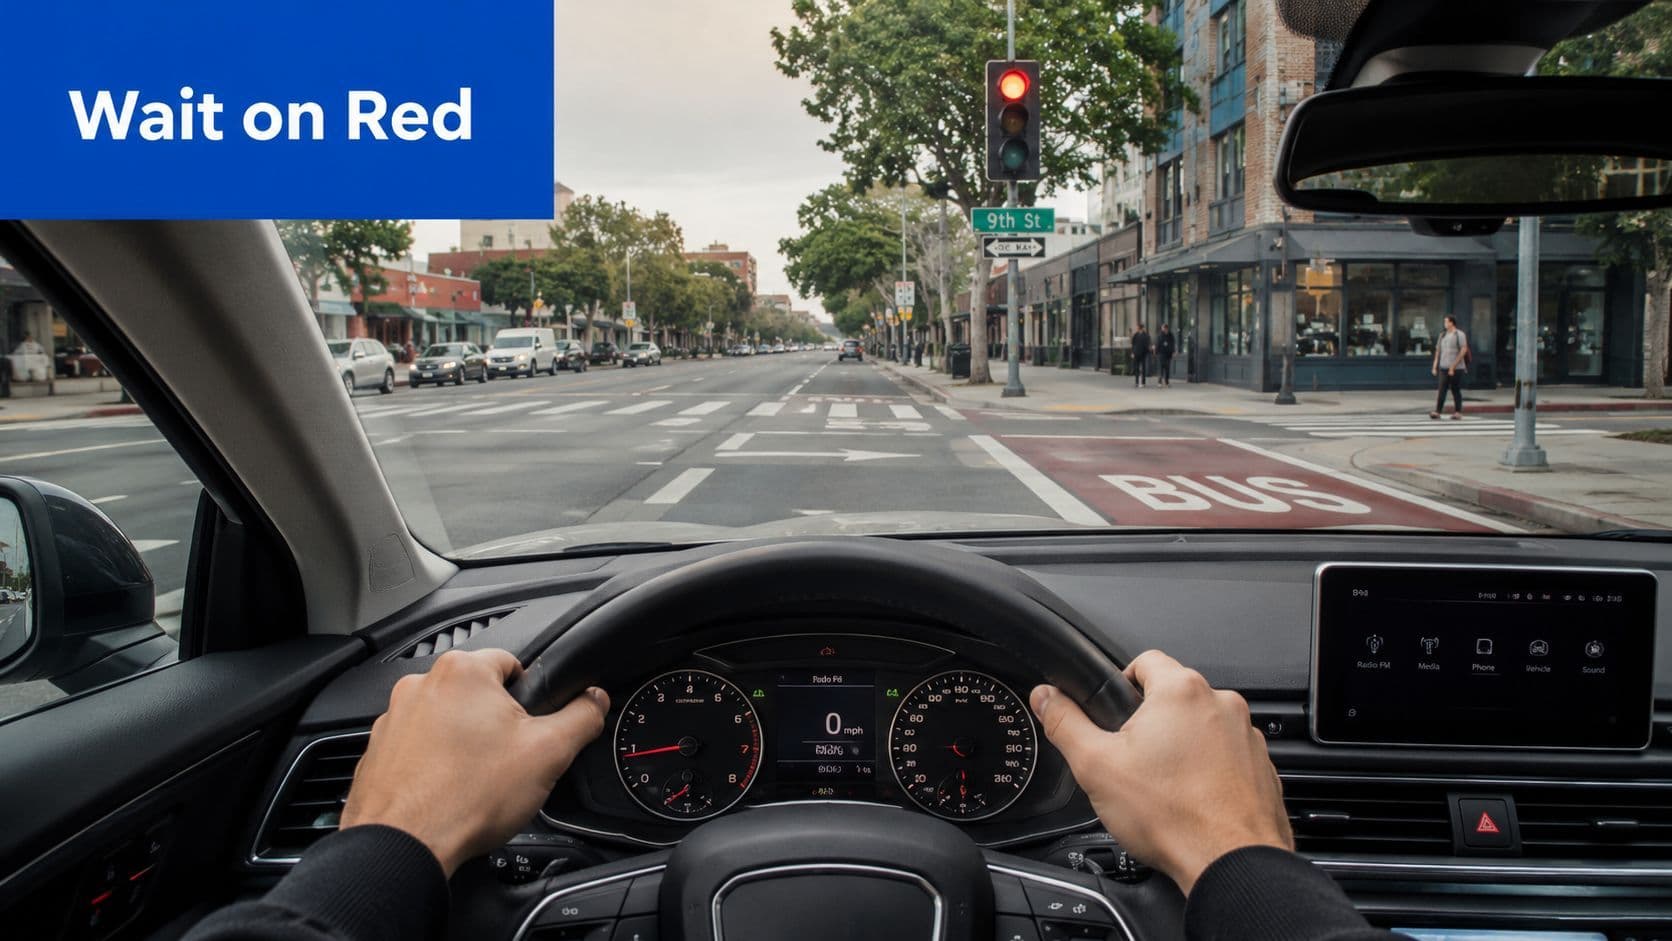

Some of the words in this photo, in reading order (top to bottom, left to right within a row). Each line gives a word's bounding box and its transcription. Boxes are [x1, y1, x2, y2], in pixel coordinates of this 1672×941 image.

[987, 212, 1015, 229] 9th
[1024, 212, 1041, 228] St
[1098, 475, 1371, 514] BUS
[1418, 662, 1440, 670] Media
[1472, 663, 1495, 672] Phone
[1582, 666, 1605, 675] Sound
[638, 714, 645, 724] 2
[734, 714, 742, 723] 6
[825, 712, 842, 735] 0
[843, 727, 864, 736] mph
[630, 744, 636, 754] 1
[640, 773, 649, 783] 0
[728, 773, 737, 783] 8
